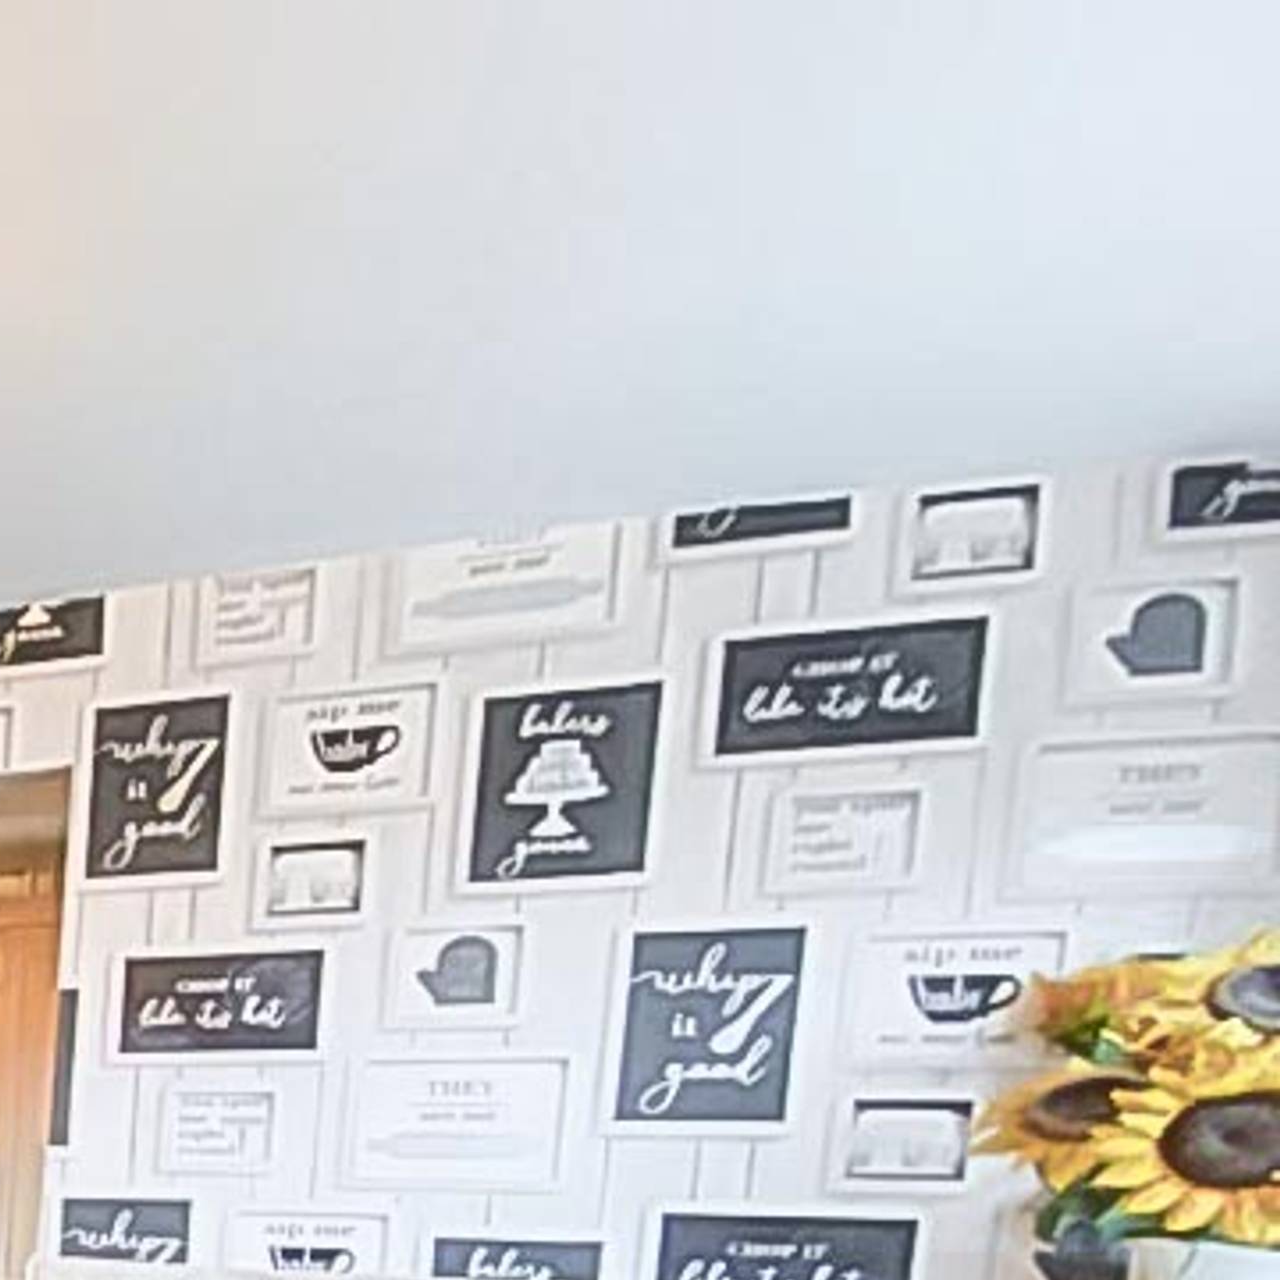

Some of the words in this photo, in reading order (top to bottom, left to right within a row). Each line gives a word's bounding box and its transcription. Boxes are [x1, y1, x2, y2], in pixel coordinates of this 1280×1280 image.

[102, 792, 206, 869] good
[627, 942, 765, 1014] whip
[639, 1034, 772, 1113] good
